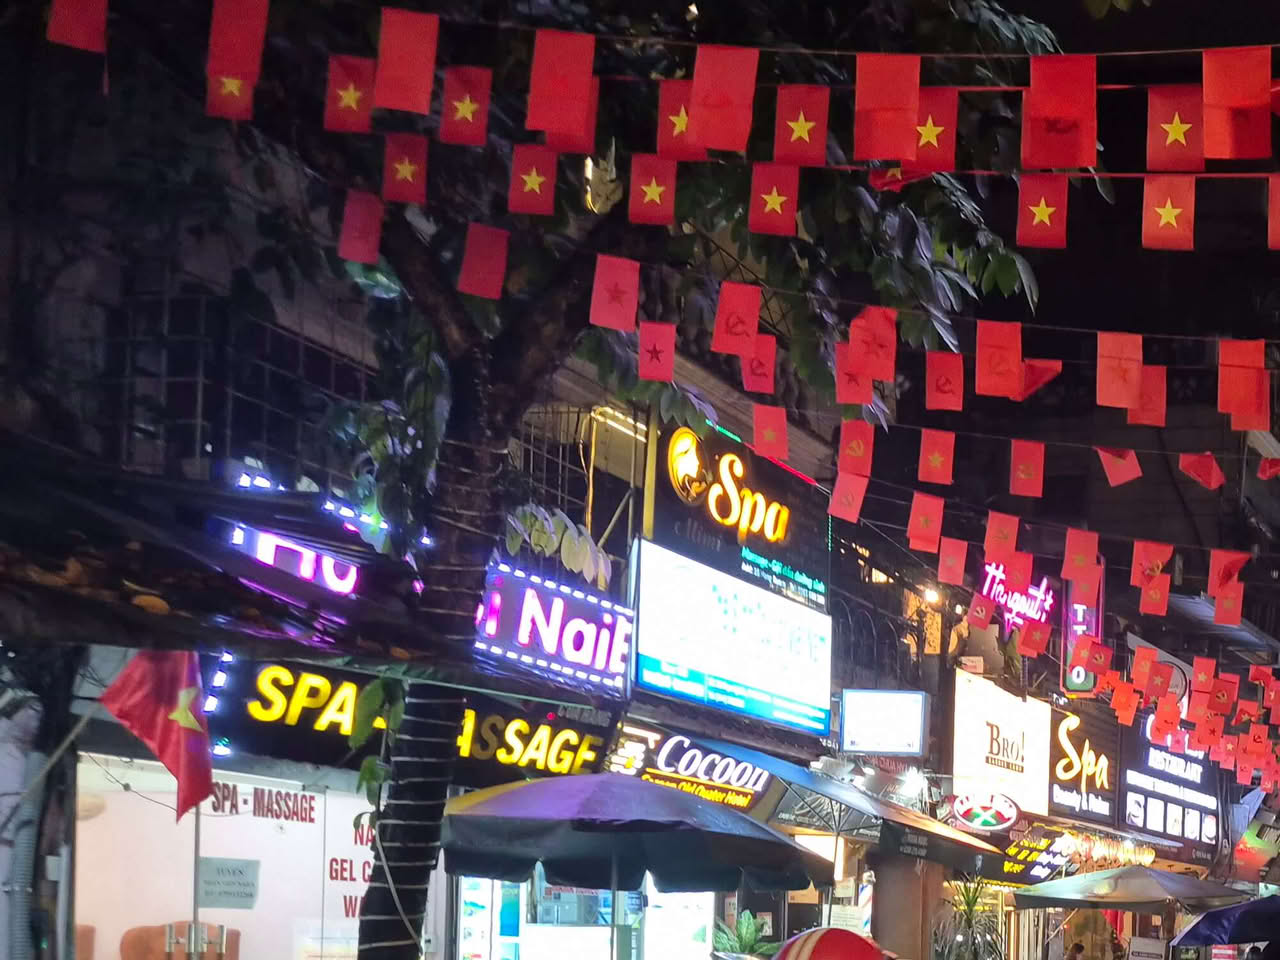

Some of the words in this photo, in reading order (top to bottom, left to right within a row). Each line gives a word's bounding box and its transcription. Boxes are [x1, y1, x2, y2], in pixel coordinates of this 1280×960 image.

[708, 453, 790, 543] Spa
[247, 665, 359, 737] SPA
[656, 735, 771, 792] Cocoon
[1055, 712, 1109, 795] Spa
[212, 782, 239, 815] SPA
[253, 787, 316, 824] MASSAGE
[329, 857, 356, 882] GEL
